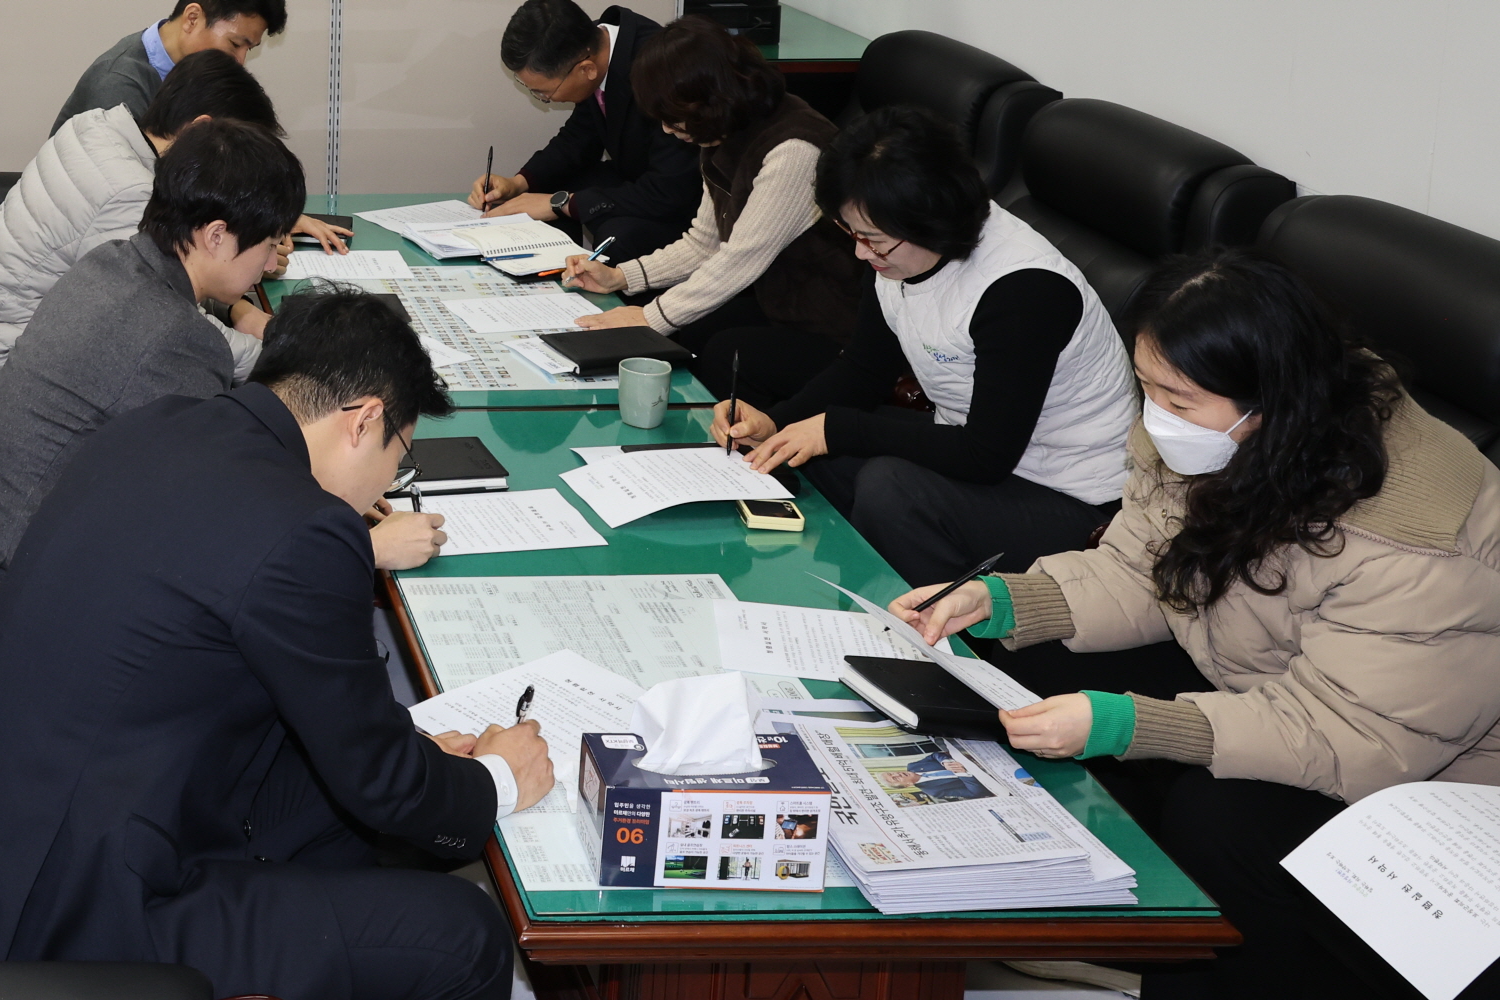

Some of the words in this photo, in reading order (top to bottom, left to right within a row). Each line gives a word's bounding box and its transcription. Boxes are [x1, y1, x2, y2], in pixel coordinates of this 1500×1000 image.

[616, 827, 645, 845] 06
[1367, 854, 1399, 882] 서약서
[1400, 882, 1445, 921] 청렴실천
